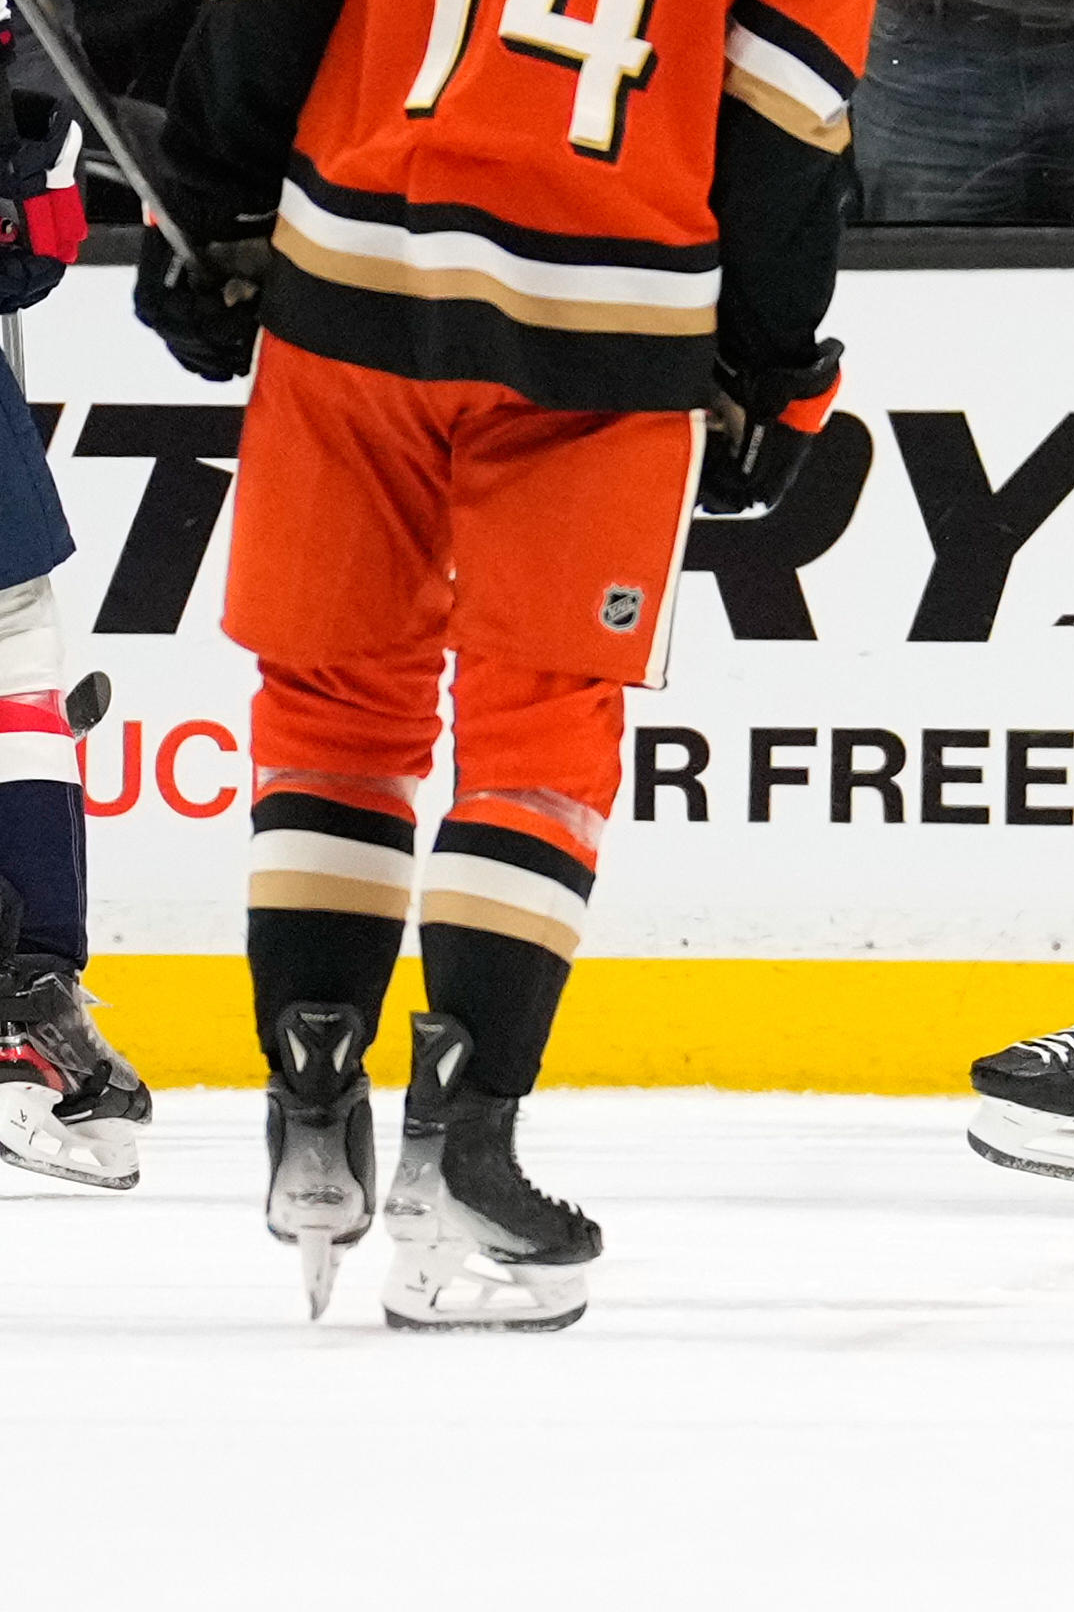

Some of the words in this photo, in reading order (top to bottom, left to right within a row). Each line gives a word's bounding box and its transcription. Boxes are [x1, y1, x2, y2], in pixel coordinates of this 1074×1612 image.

[75, 719, 254, 818] UC
[634, 726, 711, 823] R
[748, 728, 1074, 826] FREE
